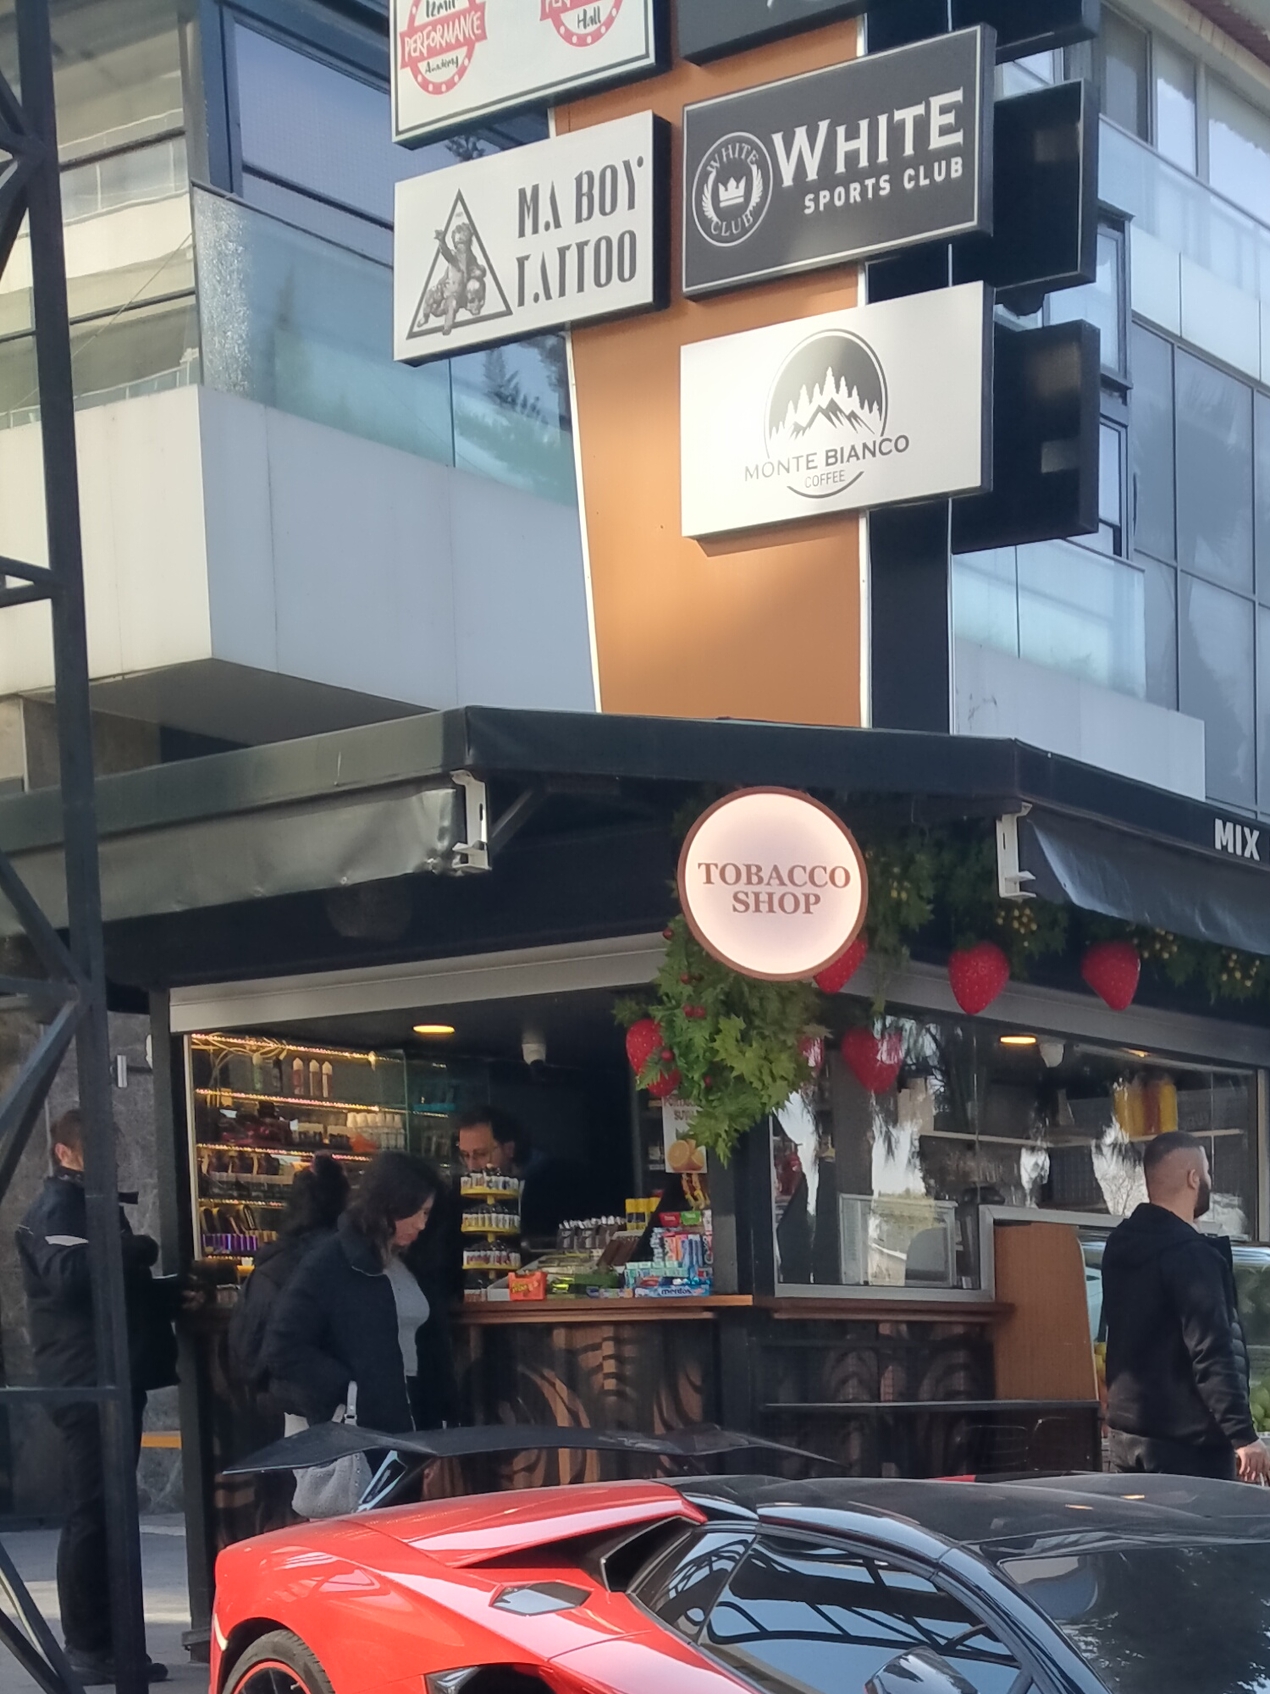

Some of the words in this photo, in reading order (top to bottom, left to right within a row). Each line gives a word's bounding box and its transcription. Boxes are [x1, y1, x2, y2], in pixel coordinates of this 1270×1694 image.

[404, 10, 482, 63] PERFORMANCE
[576, 5, 601, 30] Hall
[771, 86, 964, 188] WHITE
[706, 142, 760, 174] WHITE
[803, 174, 891, 215] SPORTS
[902, 156, 964, 190] CLUB
[710, 208, 754, 237] CLUB
[516, 229, 637, 308] TATTOO
[744, 452, 818, 482] MONTE
[824, 434, 910, 467] BIANCO
[804, 469, 846, 489] COFFEE
[1214, 817, 1261, 862] MIX
[697, 862, 851, 889] TOBACCO
[732, 890, 822, 915] SHOP
